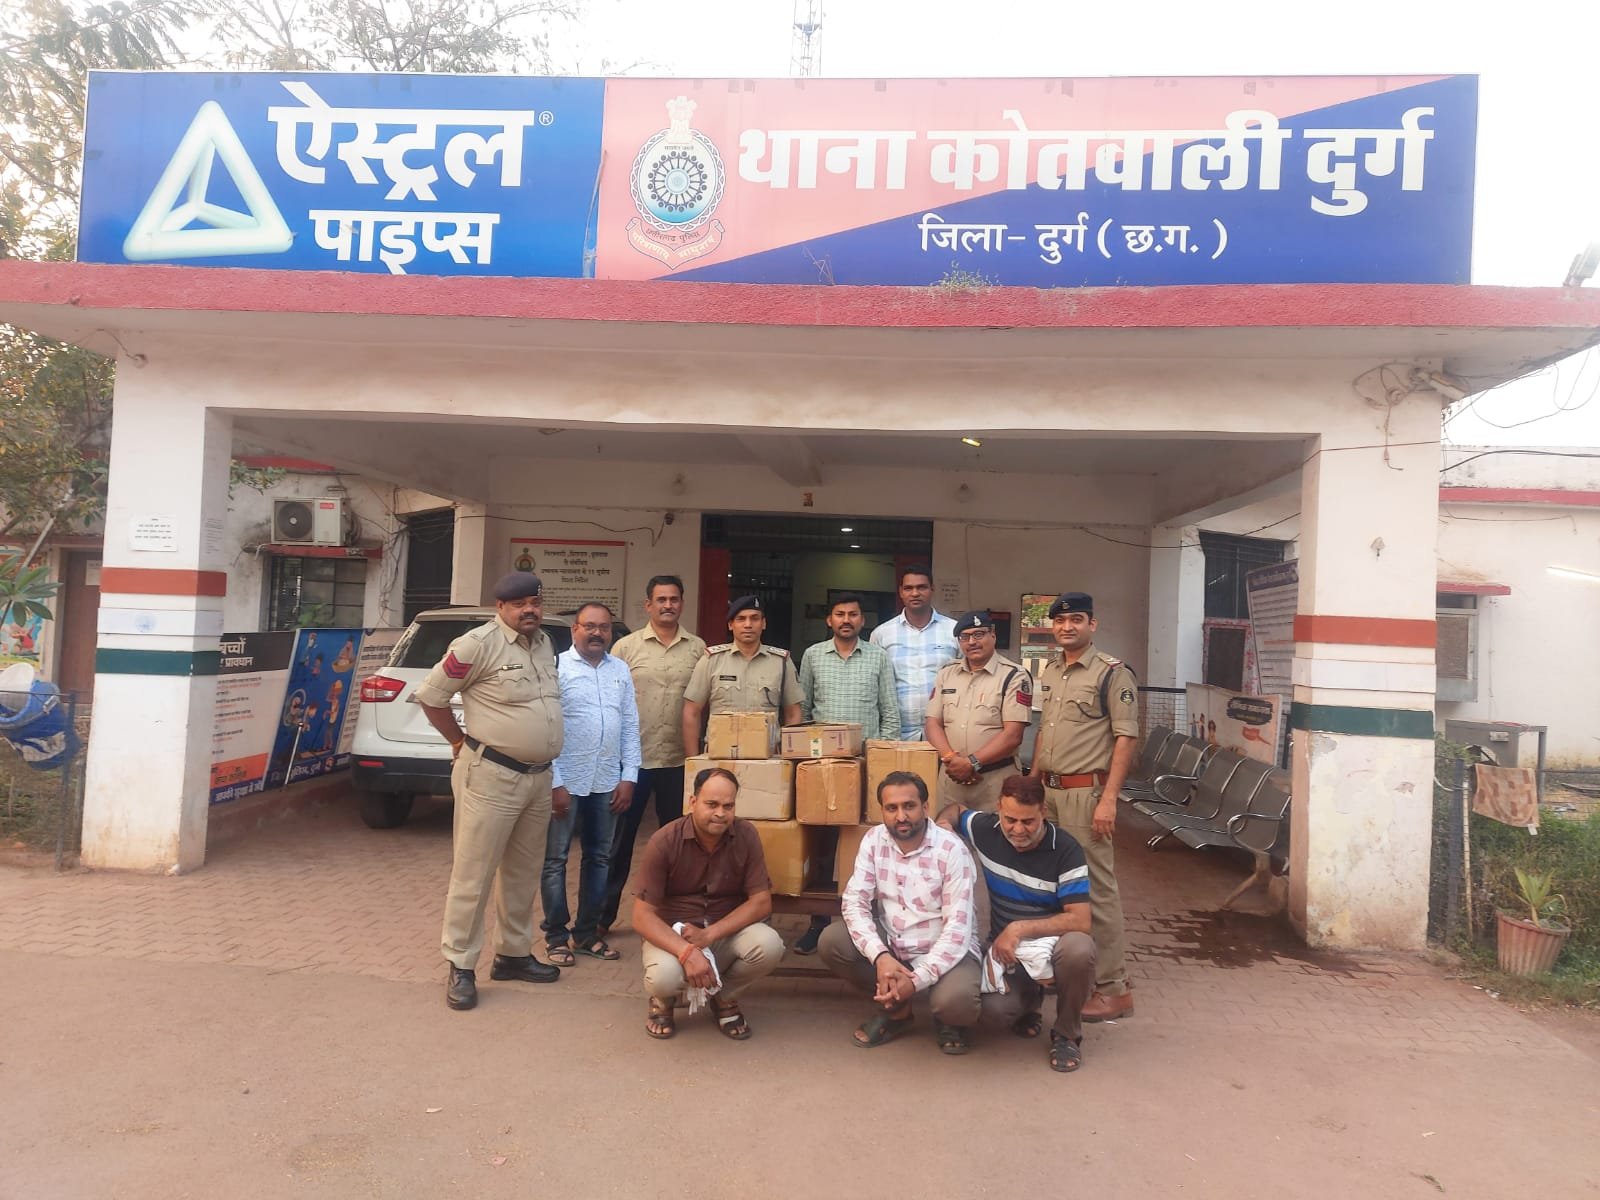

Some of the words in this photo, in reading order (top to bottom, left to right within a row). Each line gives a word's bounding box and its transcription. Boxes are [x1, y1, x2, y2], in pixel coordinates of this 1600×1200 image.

[268, 81, 534, 202] ऐस्ट्रल
[738, 127, 916, 190] थाना
[927, 108, 1292, 191] कोतवाली
[1303, 106, 1436, 217] दुर्ग
[309, 209, 500, 275] पाइप्स
[1034, 212, 1089, 265] दुर्ग
